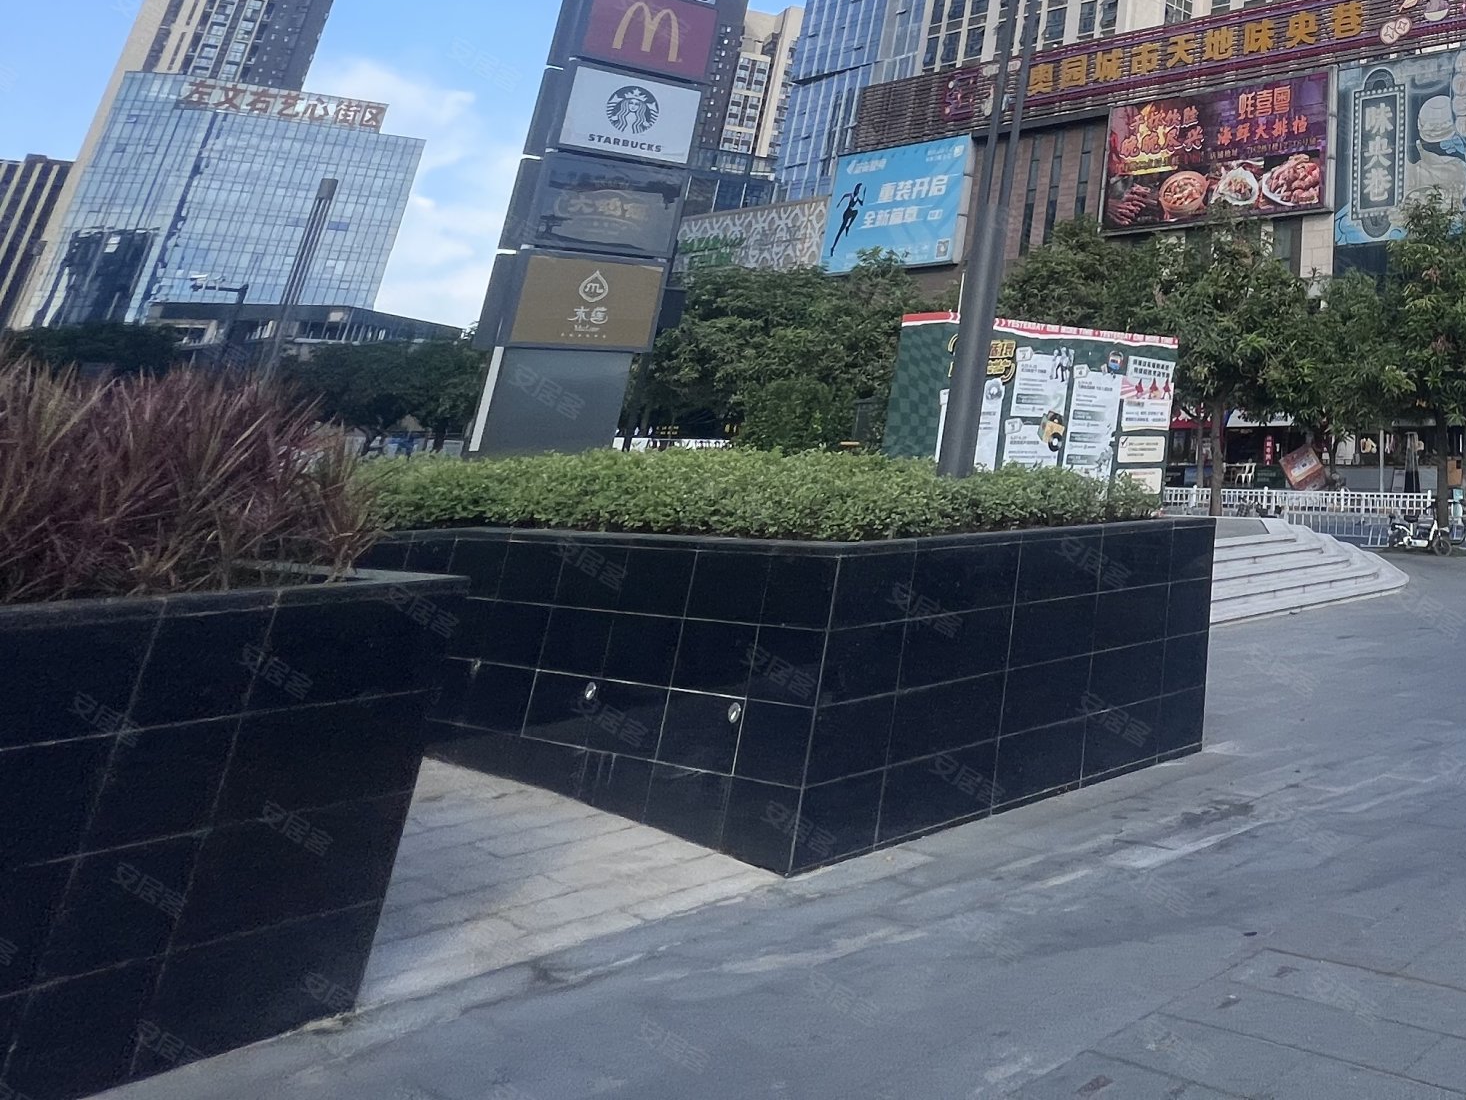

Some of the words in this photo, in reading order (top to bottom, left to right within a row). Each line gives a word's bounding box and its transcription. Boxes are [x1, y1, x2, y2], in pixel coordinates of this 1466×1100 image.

[182, 80, 388, 130] 左文右艺心街区
[588, 133, 662, 152] STARBUCKS
[1217, 115, 1308, 146] 海鲜大排档
[1363, 103, 1395, 202] 味央巷
[878, 175, 949, 203] 重装开启
